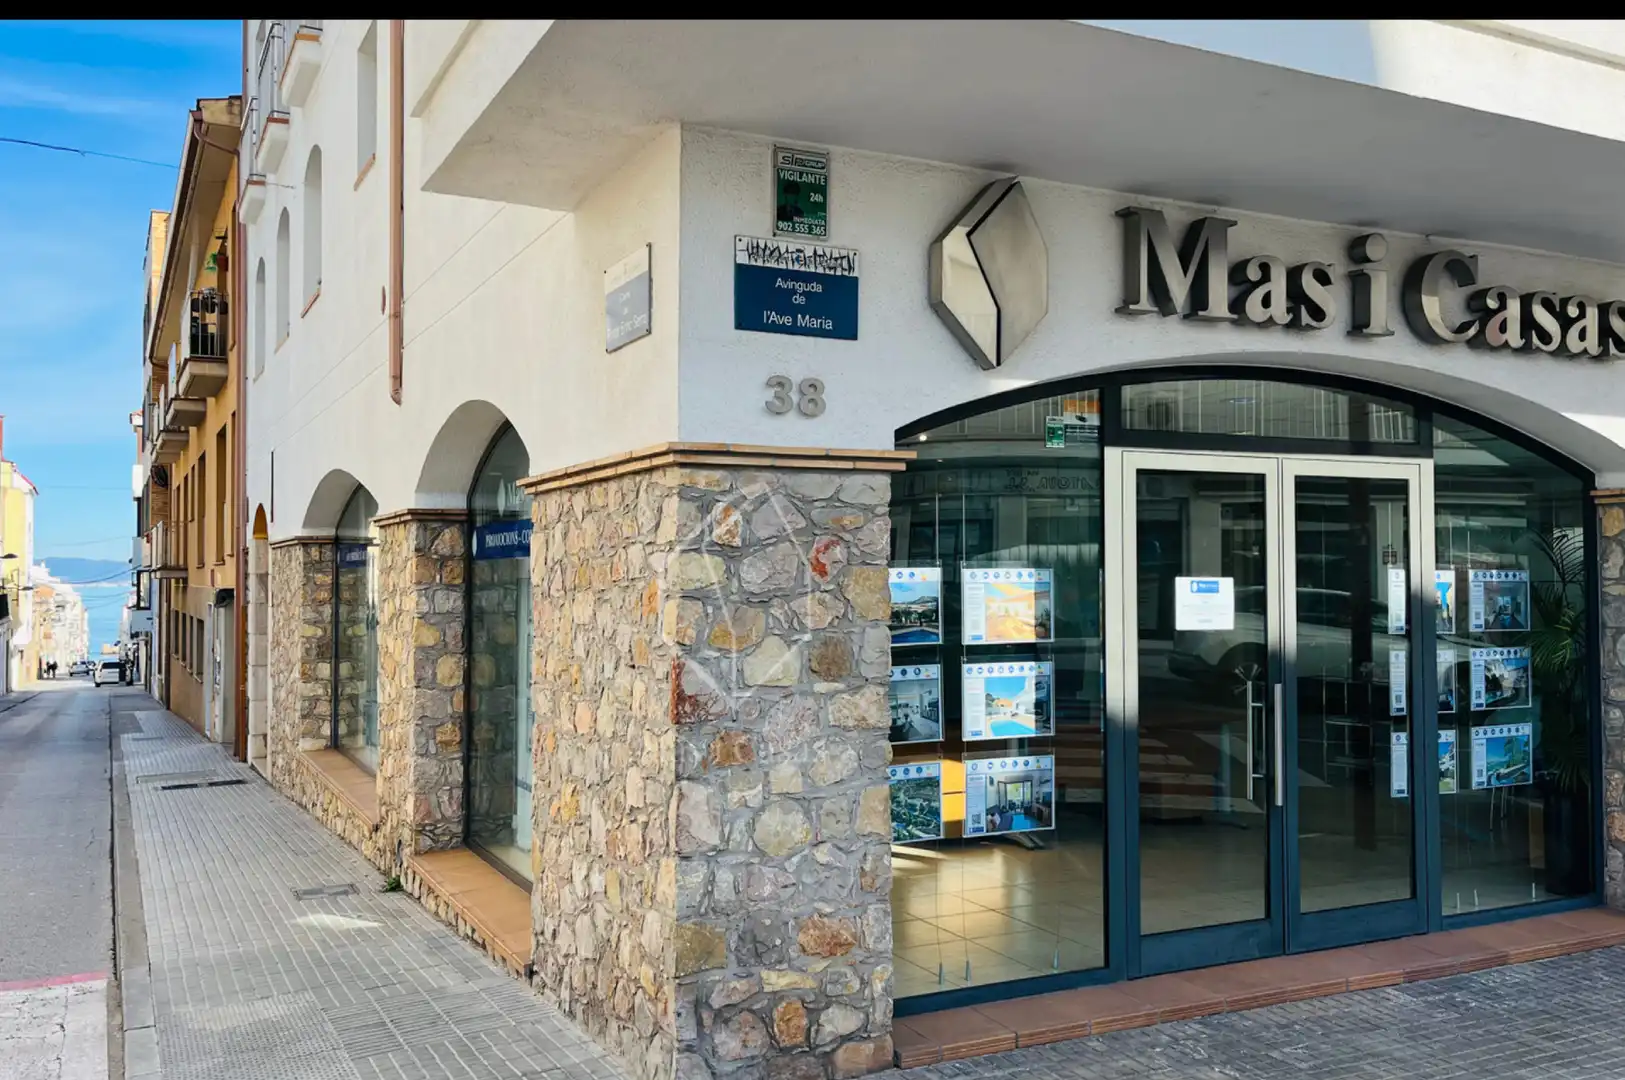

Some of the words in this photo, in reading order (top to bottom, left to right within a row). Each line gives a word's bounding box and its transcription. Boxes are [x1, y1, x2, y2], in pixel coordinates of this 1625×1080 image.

[778, 169, 825, 185] VIGILANTE
[809, 192, 824, 203] 24h
[777, 221, 793, 231] 902
[794, 224, 809, 233] 555
[811, 226, 826, 236] 365
[775, 277, 823, 293] Avinguda
[792, 293, 806, 304] de
[763, 310, 792, 325] l'Ave
[797, 314, 833, 330] Maria
[765, 374, 827, 418] 38
